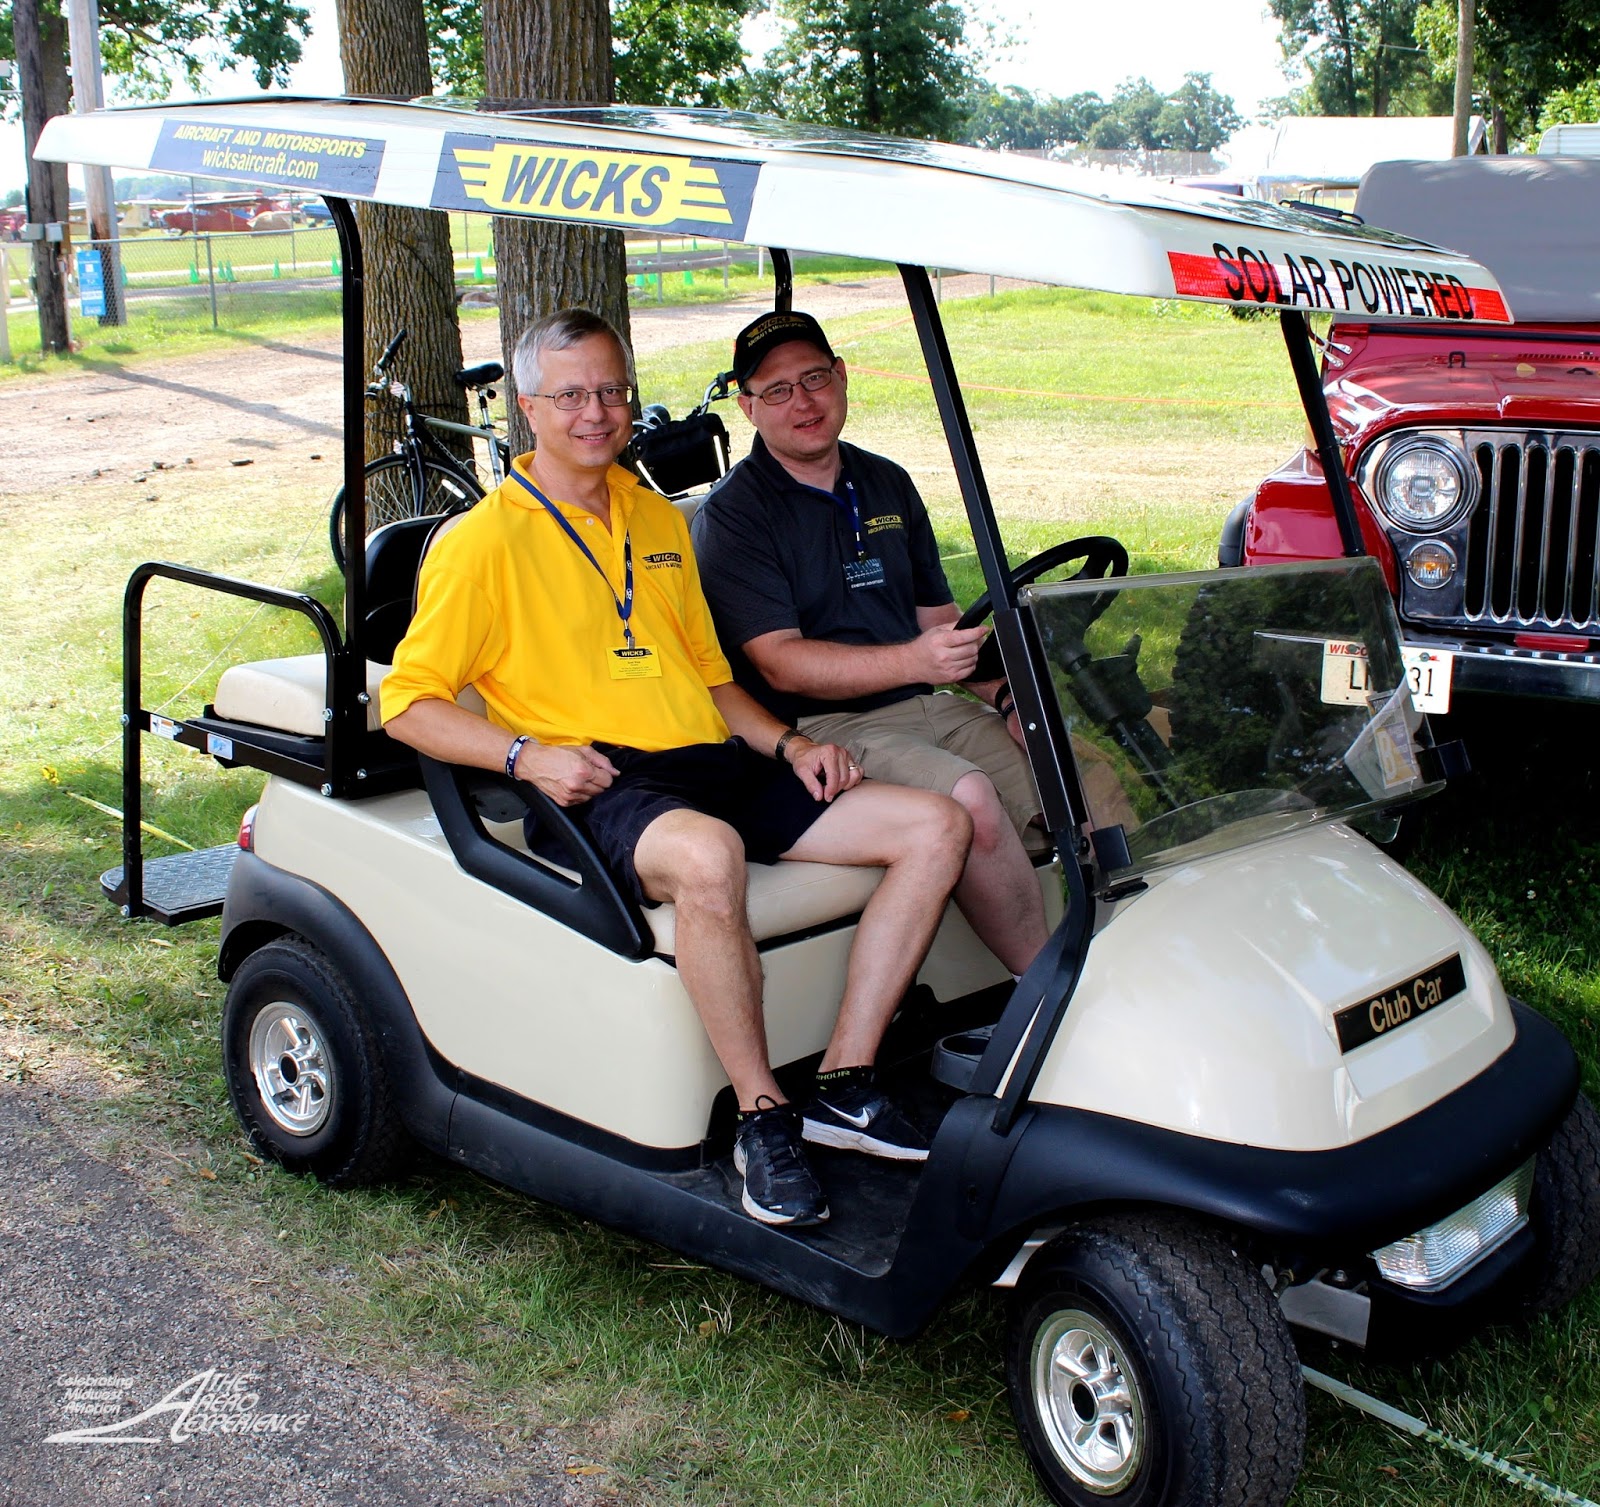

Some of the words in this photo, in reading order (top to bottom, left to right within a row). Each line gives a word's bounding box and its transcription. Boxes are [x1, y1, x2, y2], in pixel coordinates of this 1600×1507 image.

[173, 124, 235, 143] AIRCRAFT
[232, 129, 262, 146] AND
[262, 132, 367, 159] MOTORSPORTS
[202, 146, 319, 180] wicksaircraft.com
[501, 154, 670, 218] WICKS
[1212, 242, 1336, 309] SOLAR
[1329, 259, 1475, 320] POWERED
[653, 553, 681, 562] WICKS
[1369, 990, 1411, 1033] Club
[1413, 976, 1442, 1010] Car
